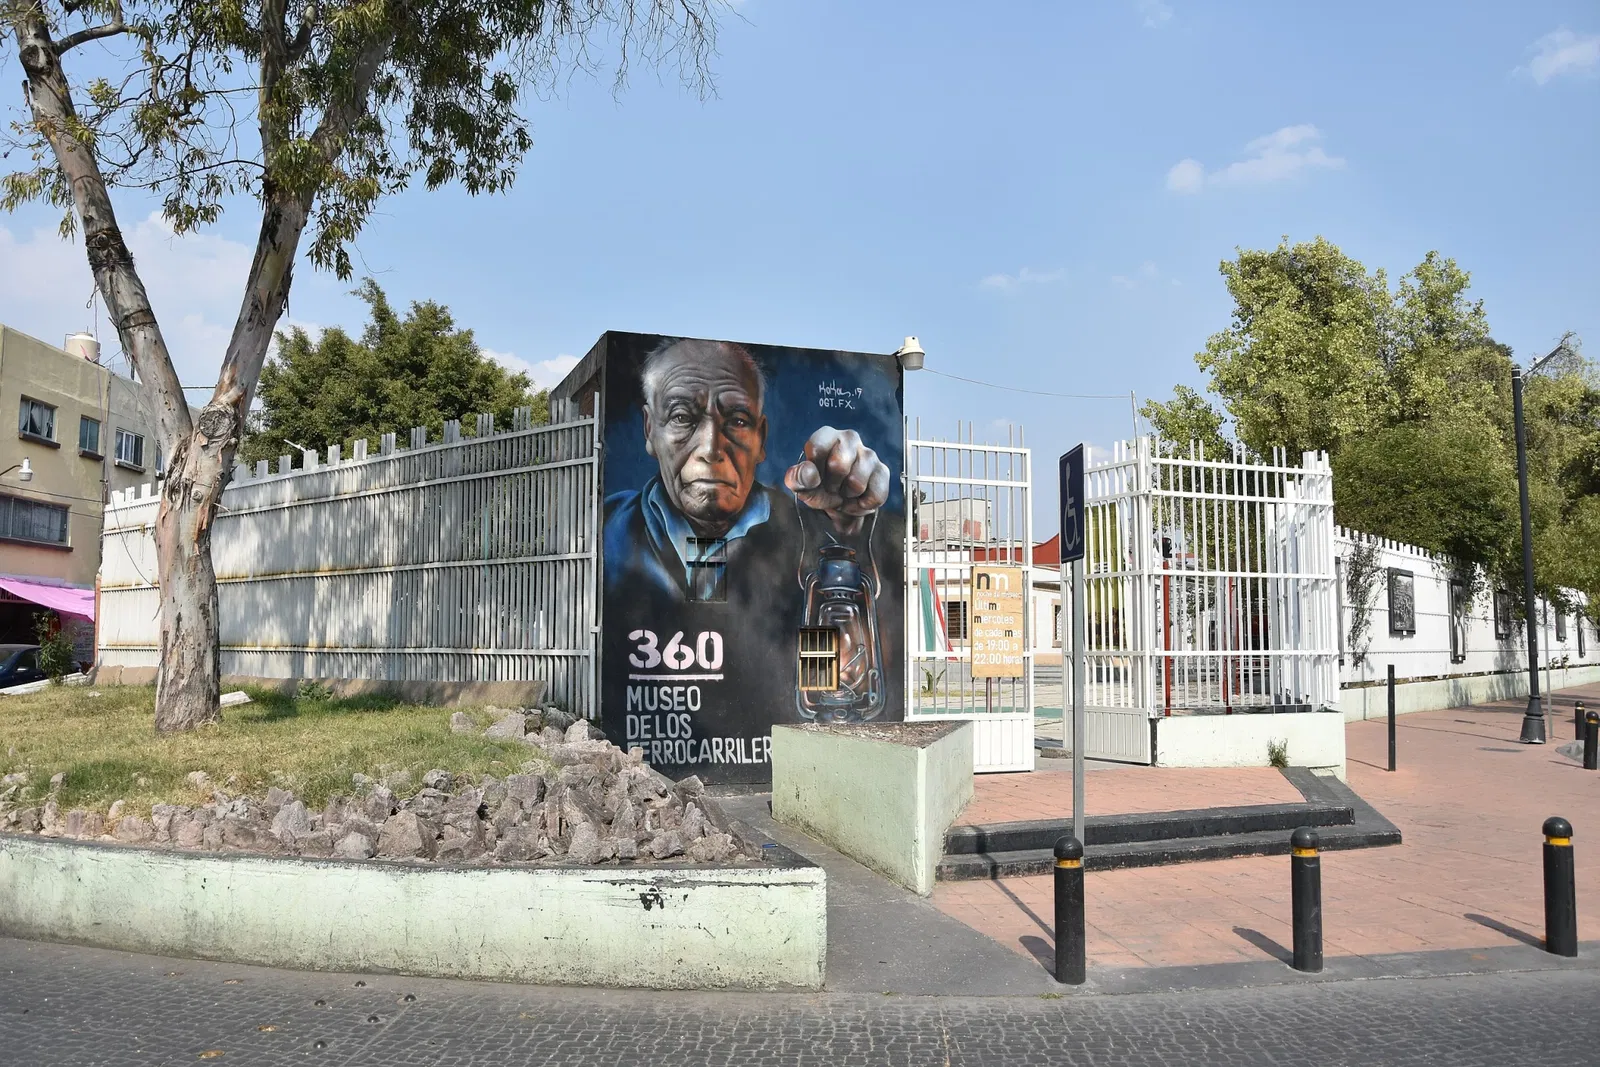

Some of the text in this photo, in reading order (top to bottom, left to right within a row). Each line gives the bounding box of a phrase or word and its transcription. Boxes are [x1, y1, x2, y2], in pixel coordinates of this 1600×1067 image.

[975, 628, 1022, 637] de cada mes
[628, 629, 724, 670] 360
[975, 639, 1018, 651] de 19:00 a
[974, 653, 1023, 665] 22:00 horas
[626, 685, 701, 711] MUSEO
[626, 713, 692, 740] DE LOS
